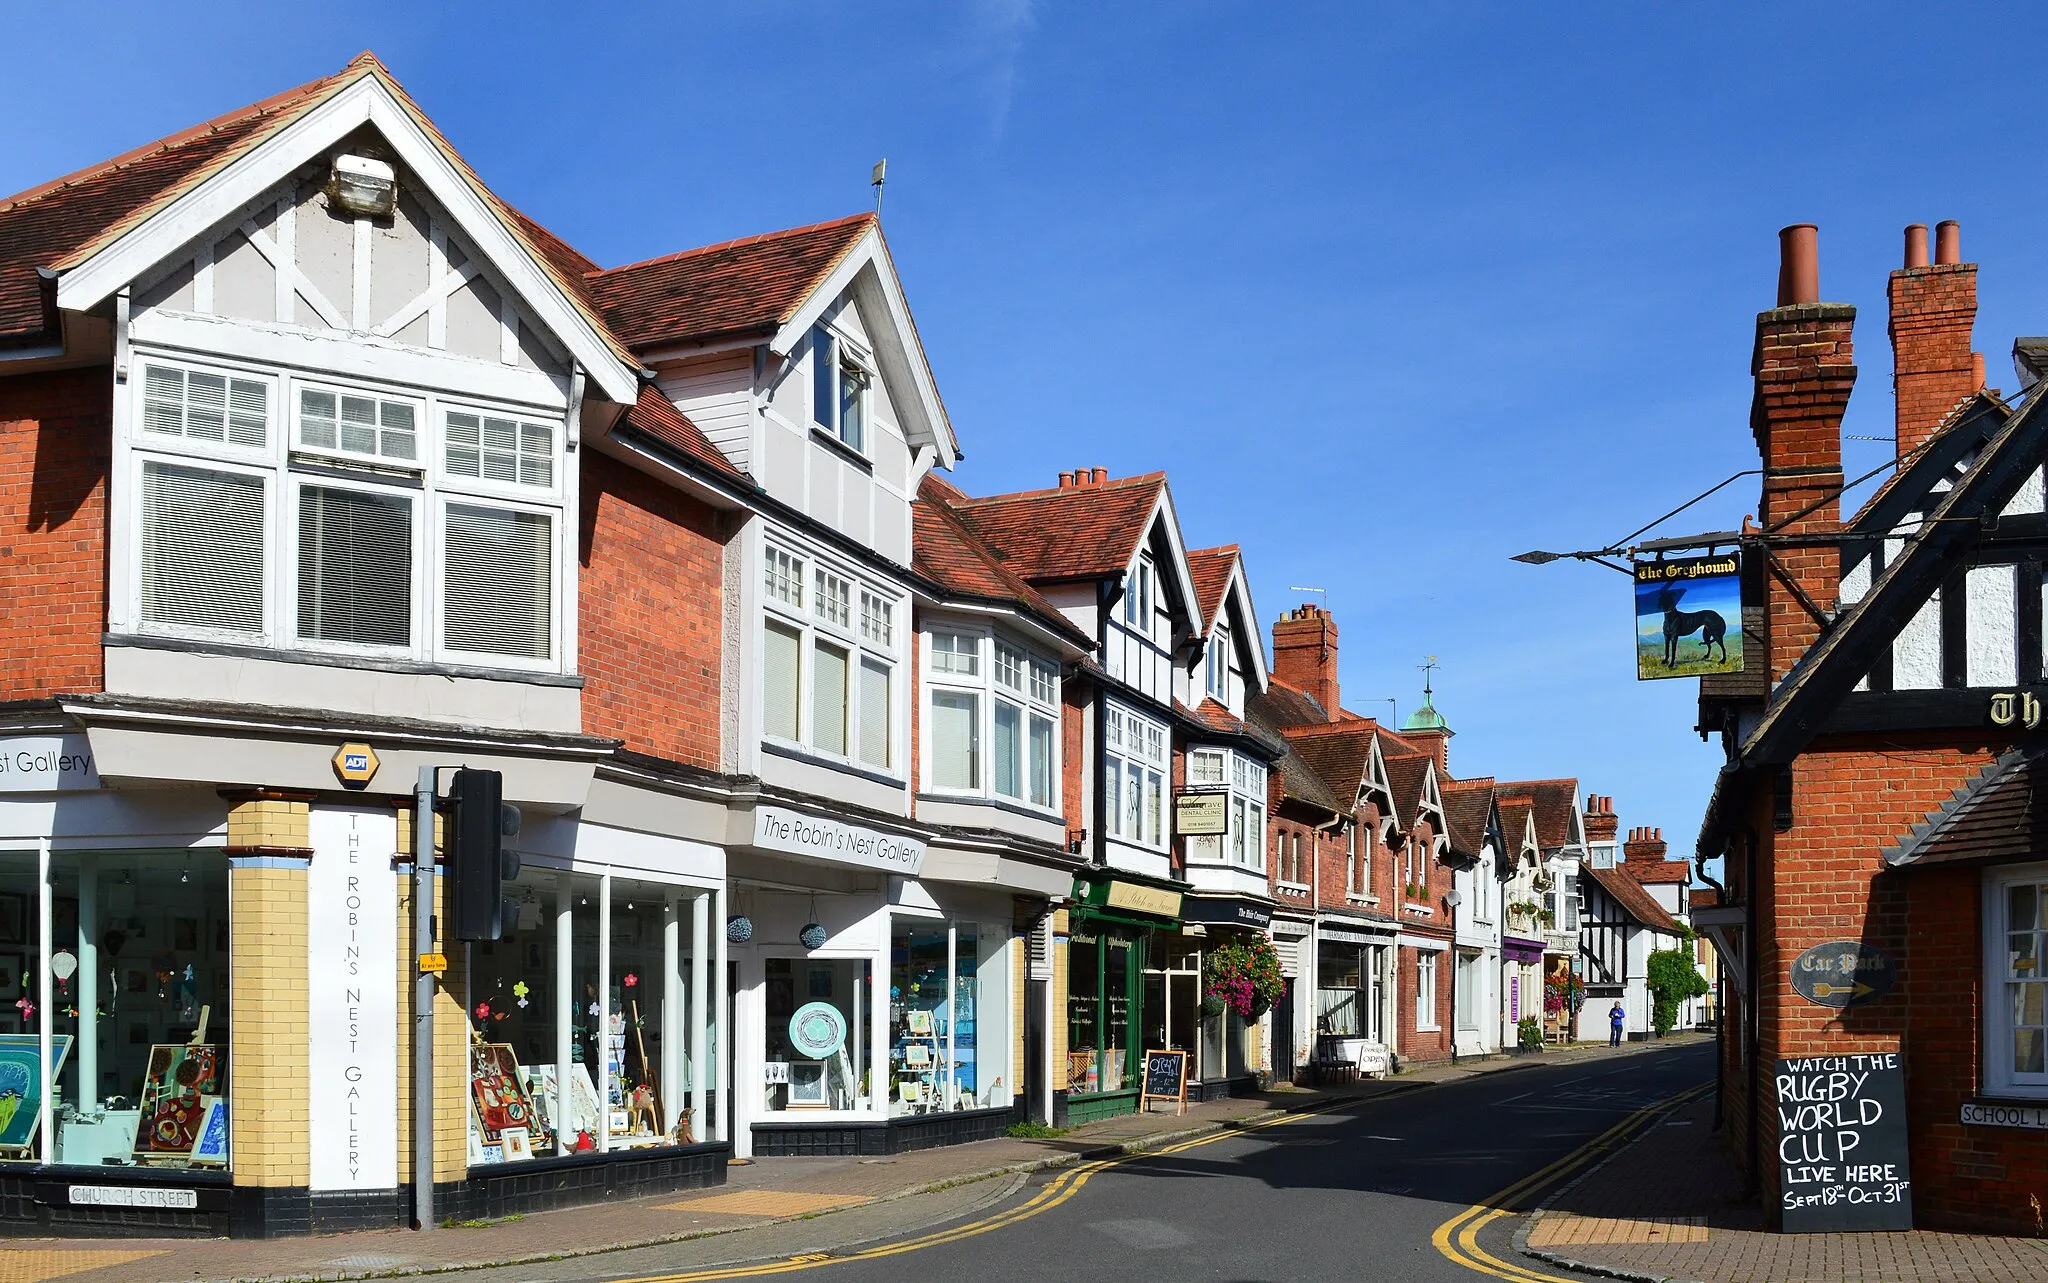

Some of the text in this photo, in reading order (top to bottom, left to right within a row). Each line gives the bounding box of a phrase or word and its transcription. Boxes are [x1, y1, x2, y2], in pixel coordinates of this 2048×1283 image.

[1639, 558, 1736, 580] The Greyhound
[1990, 691, 2048, 730] Th
[16, 750, 91, 776] Gallery
[346, 757, 367, 768] ADT
[1180, 809, 1202, 817] DENTAL
[348, 814, 360, 864] THE
[764, 814, 921, 868] The Robin's Nest Gallery
[1238, 907, 1246, 917] The
[1253, 910, 1270, 924] Company
[1800, 952, 1885, 975] Car Park
[346, 988, 361, 1053] NEST
[1786, 1053, 1898, 1072] WATCH THE
[1775, 1071, 1870, 1103] RUGBY
[344, 1066, 362, 1181] GALLERY
[1778, 1098, 1883, 1131] WORLD
[1963, 1106, 2048, 1126] SCHOOL L
[1779, 1130, 1861, 1165] CUP
[1786, 1163, 1899, 1184] LIVE HERE
[71, 1187, 194, 1206] CHURCH STREET
